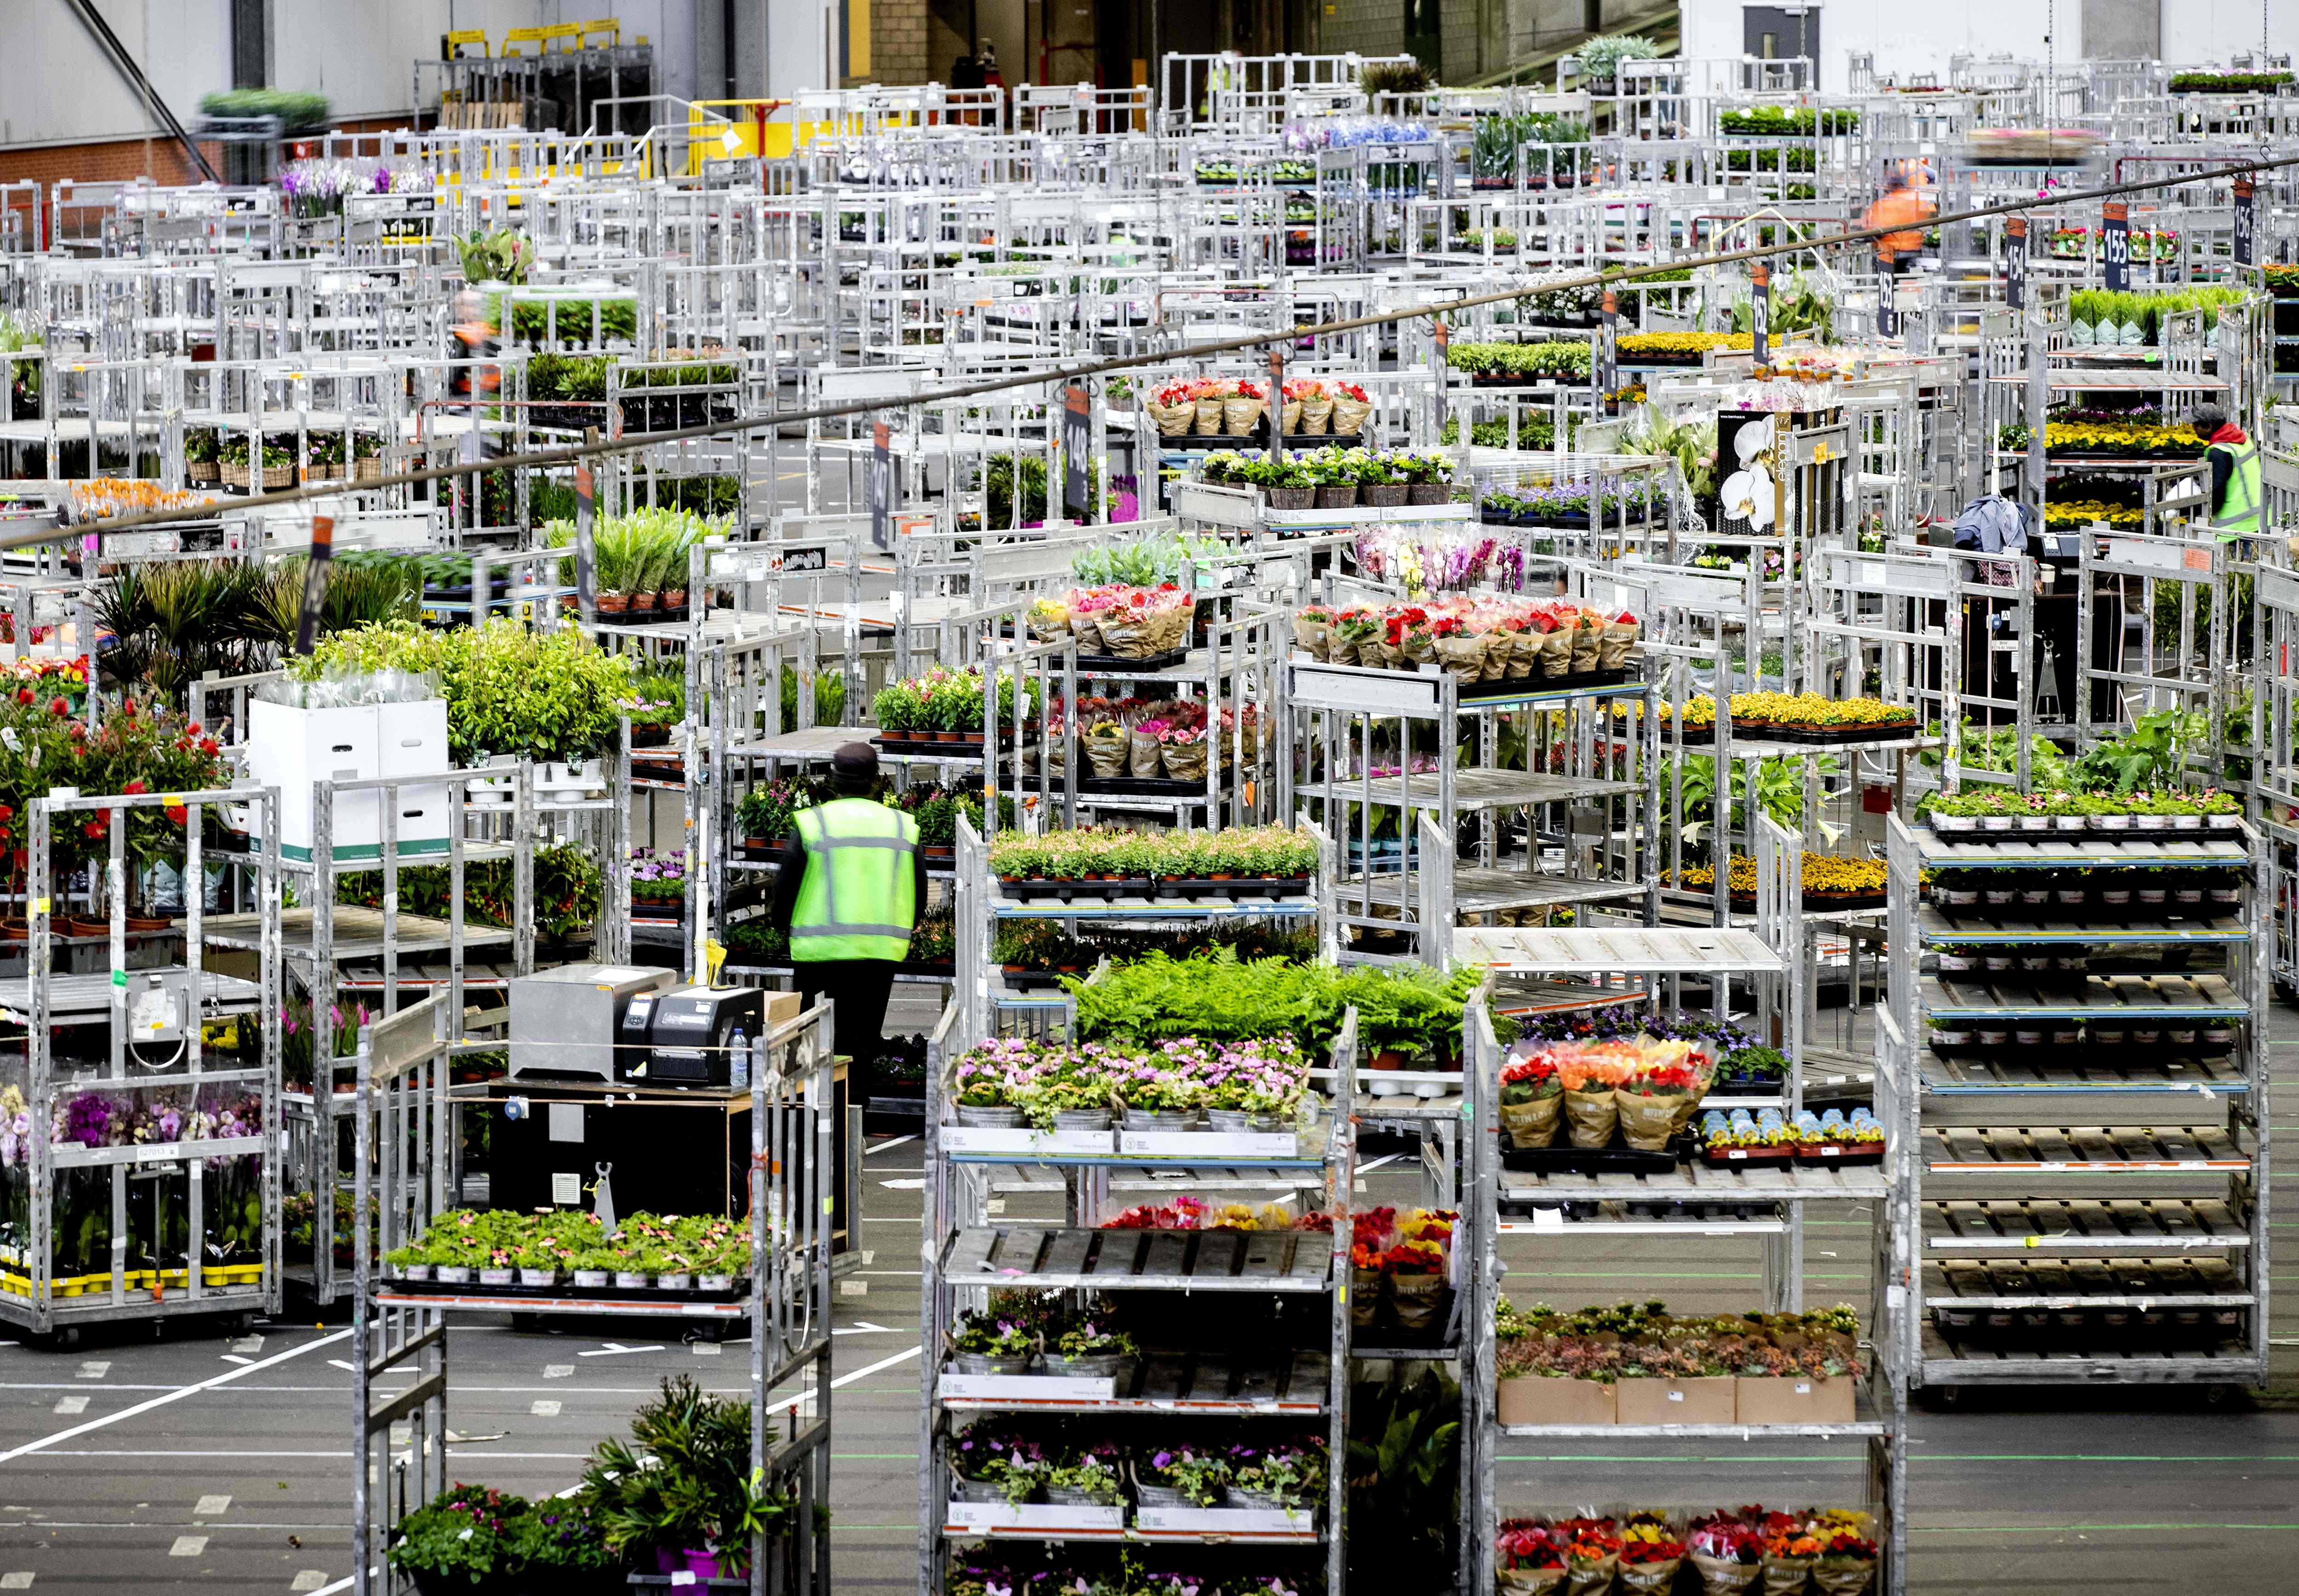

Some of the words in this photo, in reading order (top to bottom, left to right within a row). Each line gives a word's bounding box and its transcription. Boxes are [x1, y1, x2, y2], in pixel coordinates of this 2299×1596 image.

[2235, 205, 2250, 239] 156
[2008, 245, 2024, 281] 154
[2105, 229, 2127, 264] 155
[1879, 271, 1893, 310] 153
[1753, 295, 1767, 335] 152
[1067, 423, 1087, 474] 148
[1775, 429, 1787, 481] elegant
[1092, 744, 1107, 753] WITH
